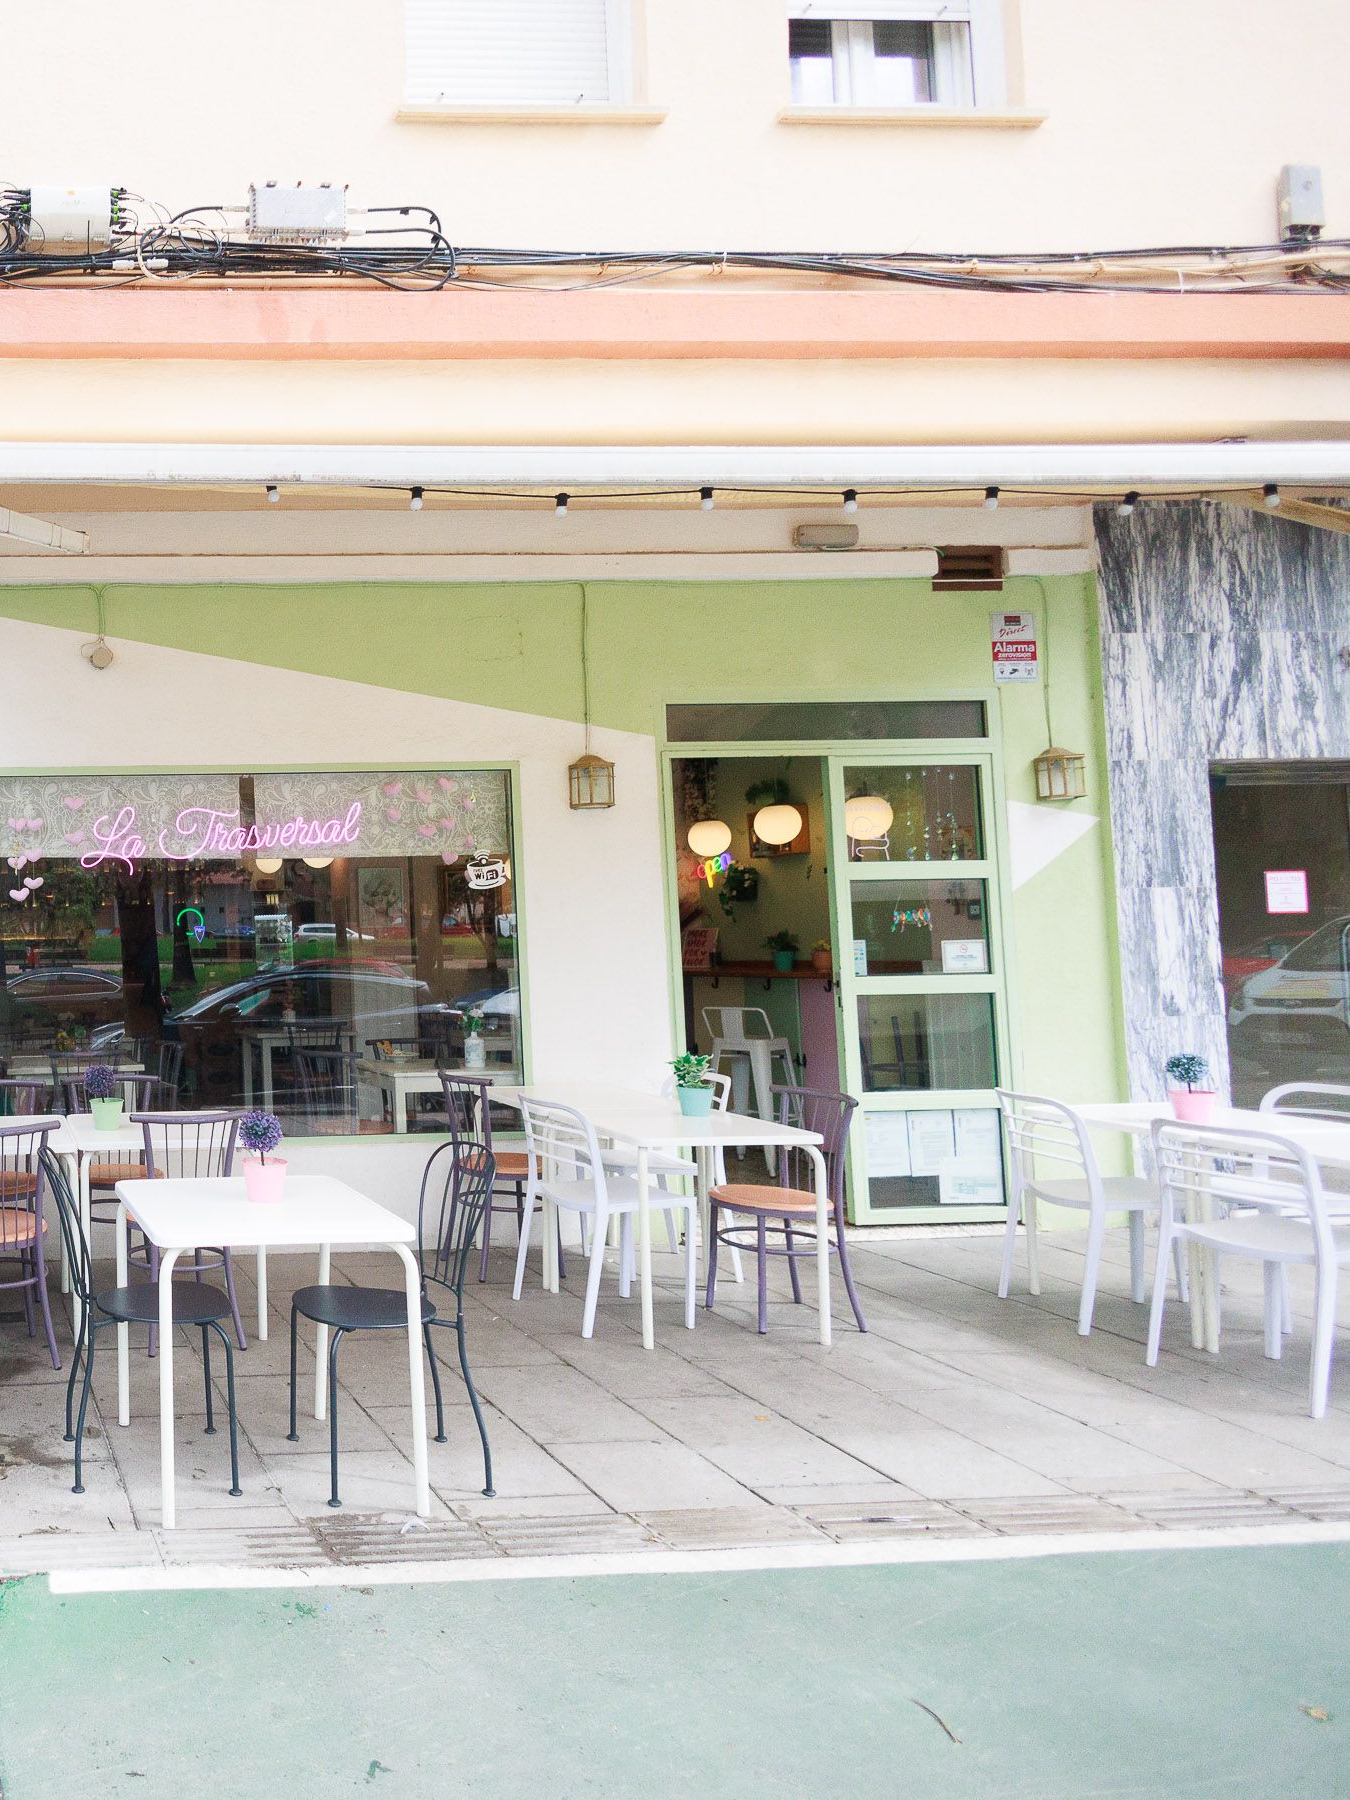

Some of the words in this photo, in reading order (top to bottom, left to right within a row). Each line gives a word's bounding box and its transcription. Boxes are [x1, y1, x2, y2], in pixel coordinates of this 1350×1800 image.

[994, 642, 1035, 652] Alarma
[81, 806, 147, 876] La
[158, 802, 362, 860] Trasversal
[697, 852, 733, 889] open
